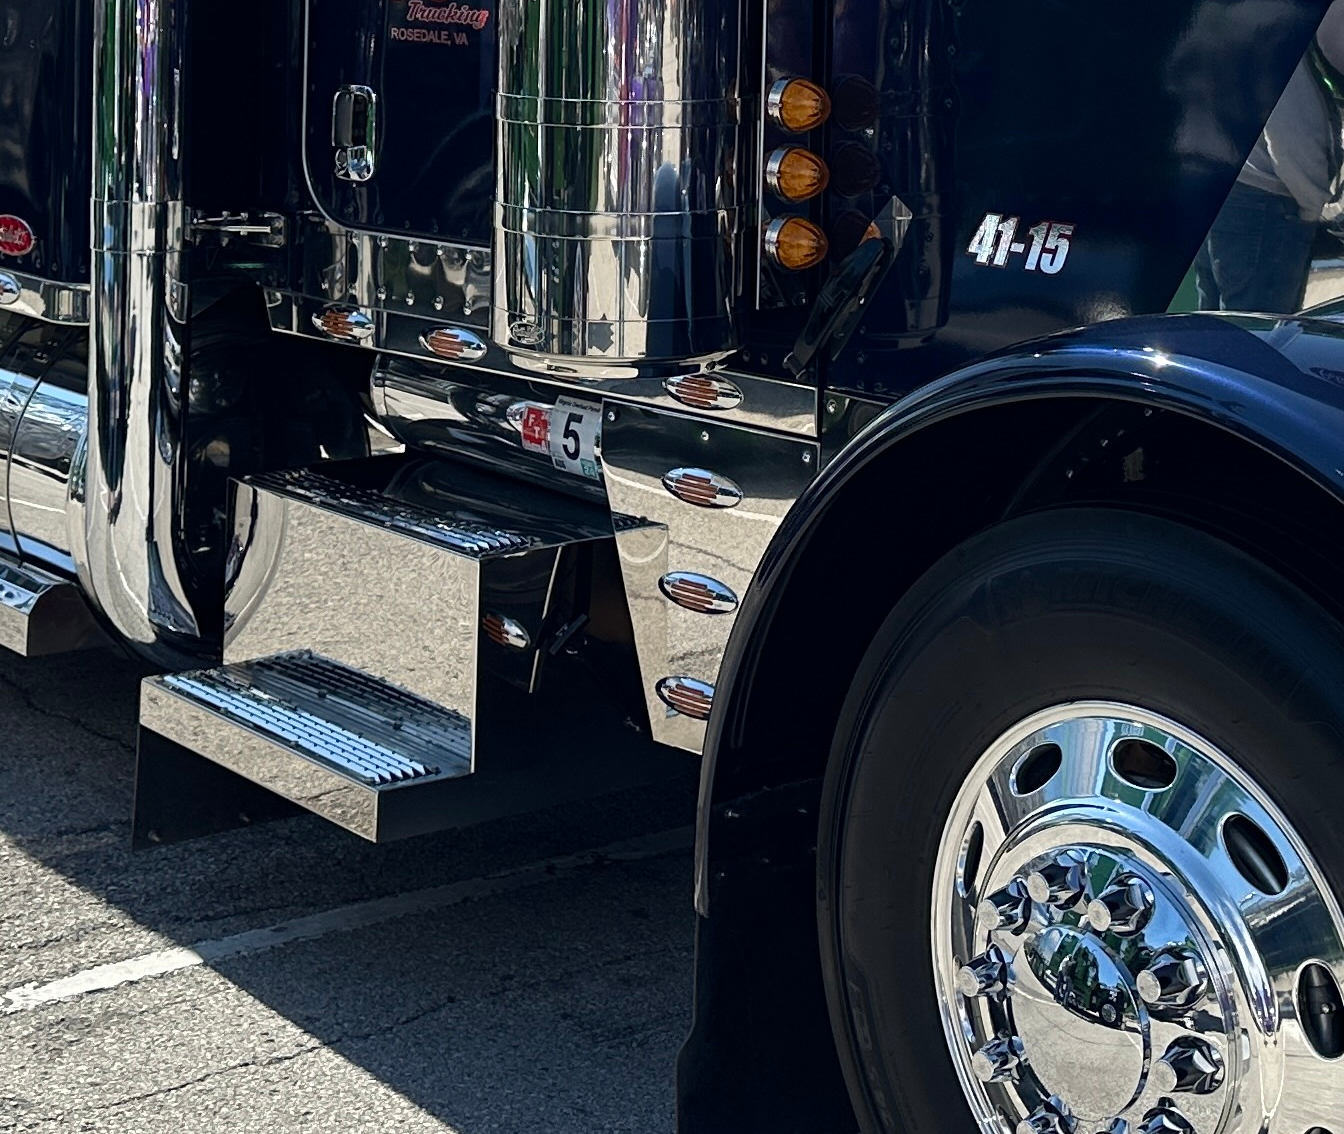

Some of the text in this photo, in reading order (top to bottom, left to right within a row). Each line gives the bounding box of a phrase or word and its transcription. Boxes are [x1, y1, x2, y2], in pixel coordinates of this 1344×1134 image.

[406, 0, 489, 31] Trucking
[390, 27, 469, 47] ROSEDALE, VA
[966, 212, 1076, 275] 41-15
[562, 412, 584, 461] 5
